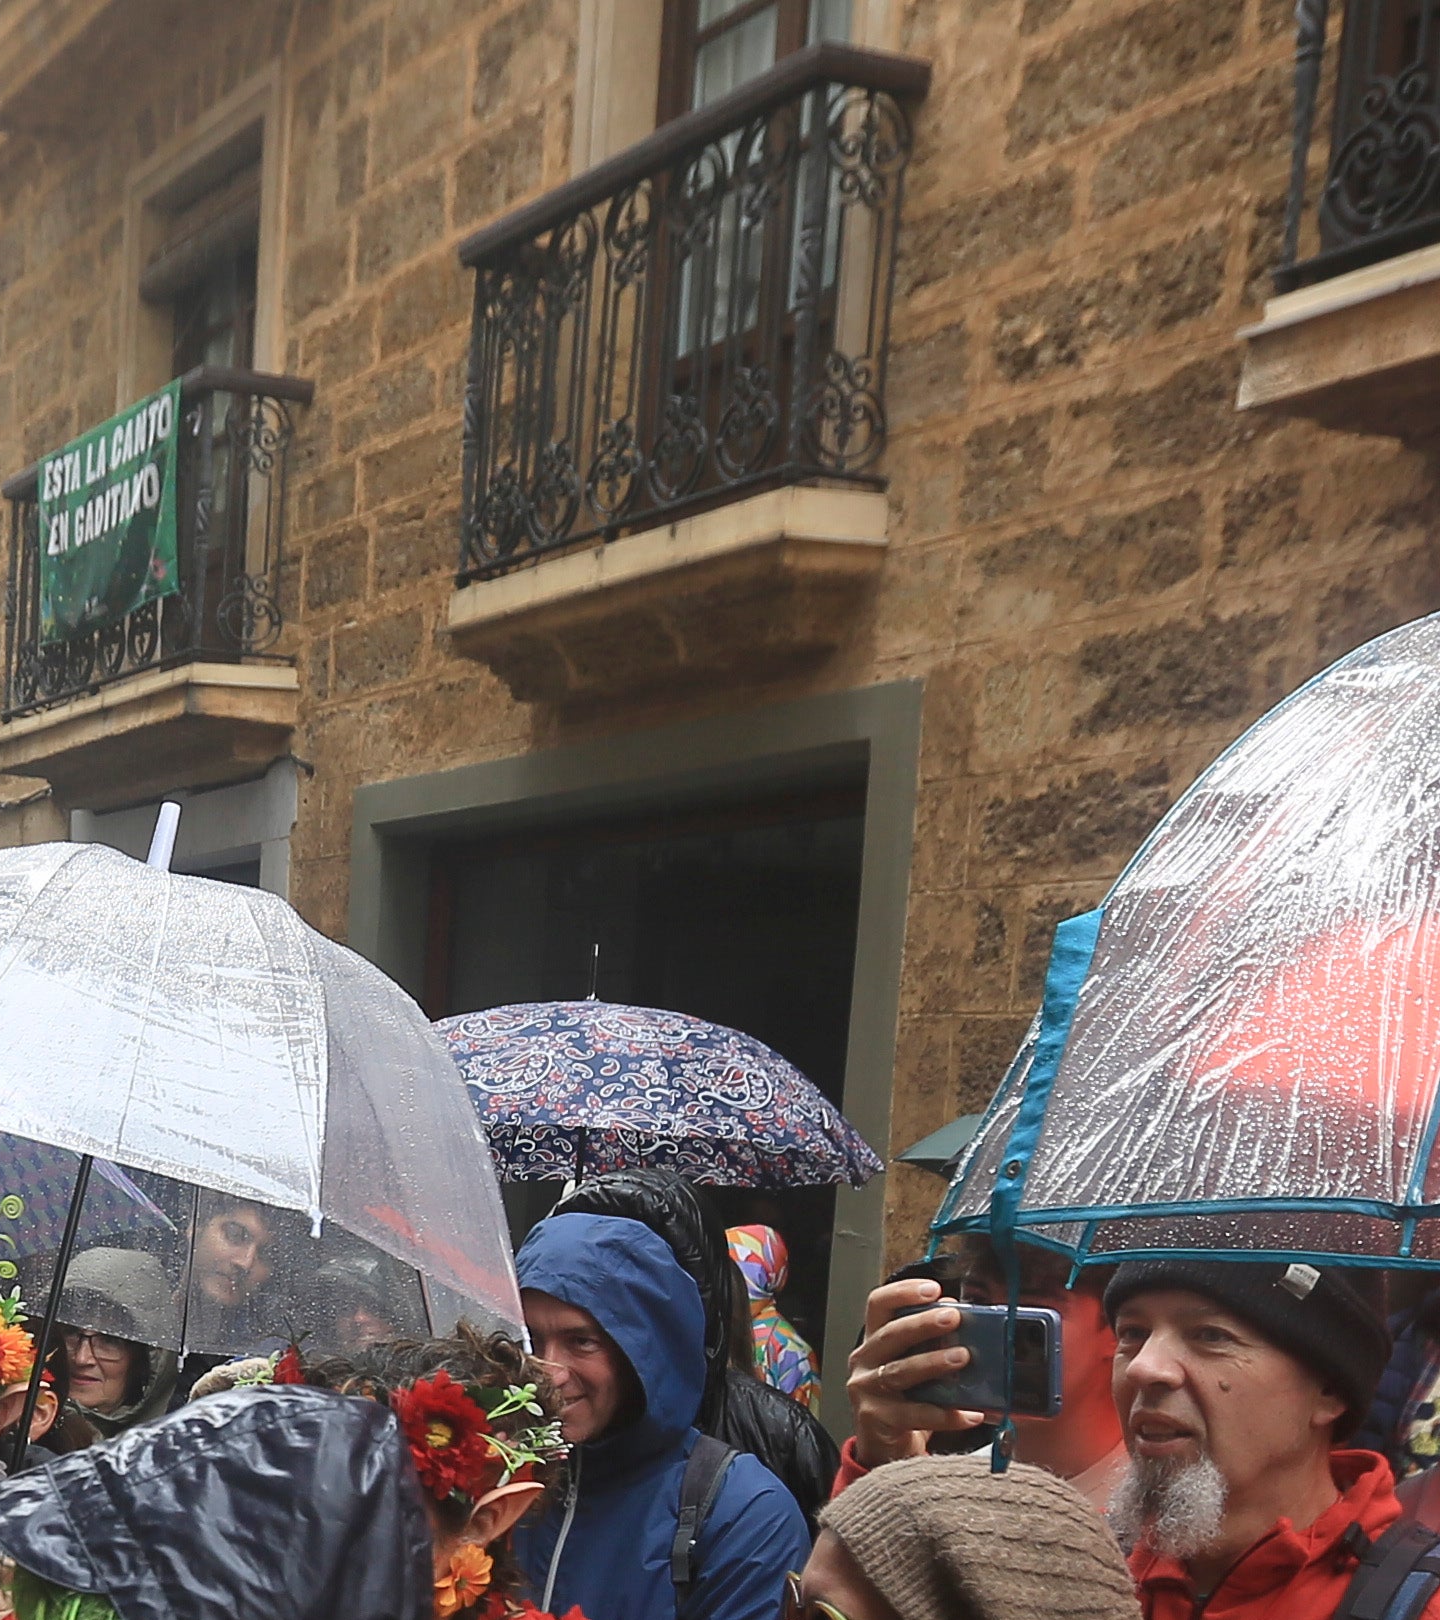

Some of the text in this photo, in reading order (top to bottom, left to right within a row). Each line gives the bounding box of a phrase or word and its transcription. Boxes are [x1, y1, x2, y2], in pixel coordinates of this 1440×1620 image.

[43, 393, 173, 502] ESTA LA CANTO
[47, 509, 69, 556] EN
